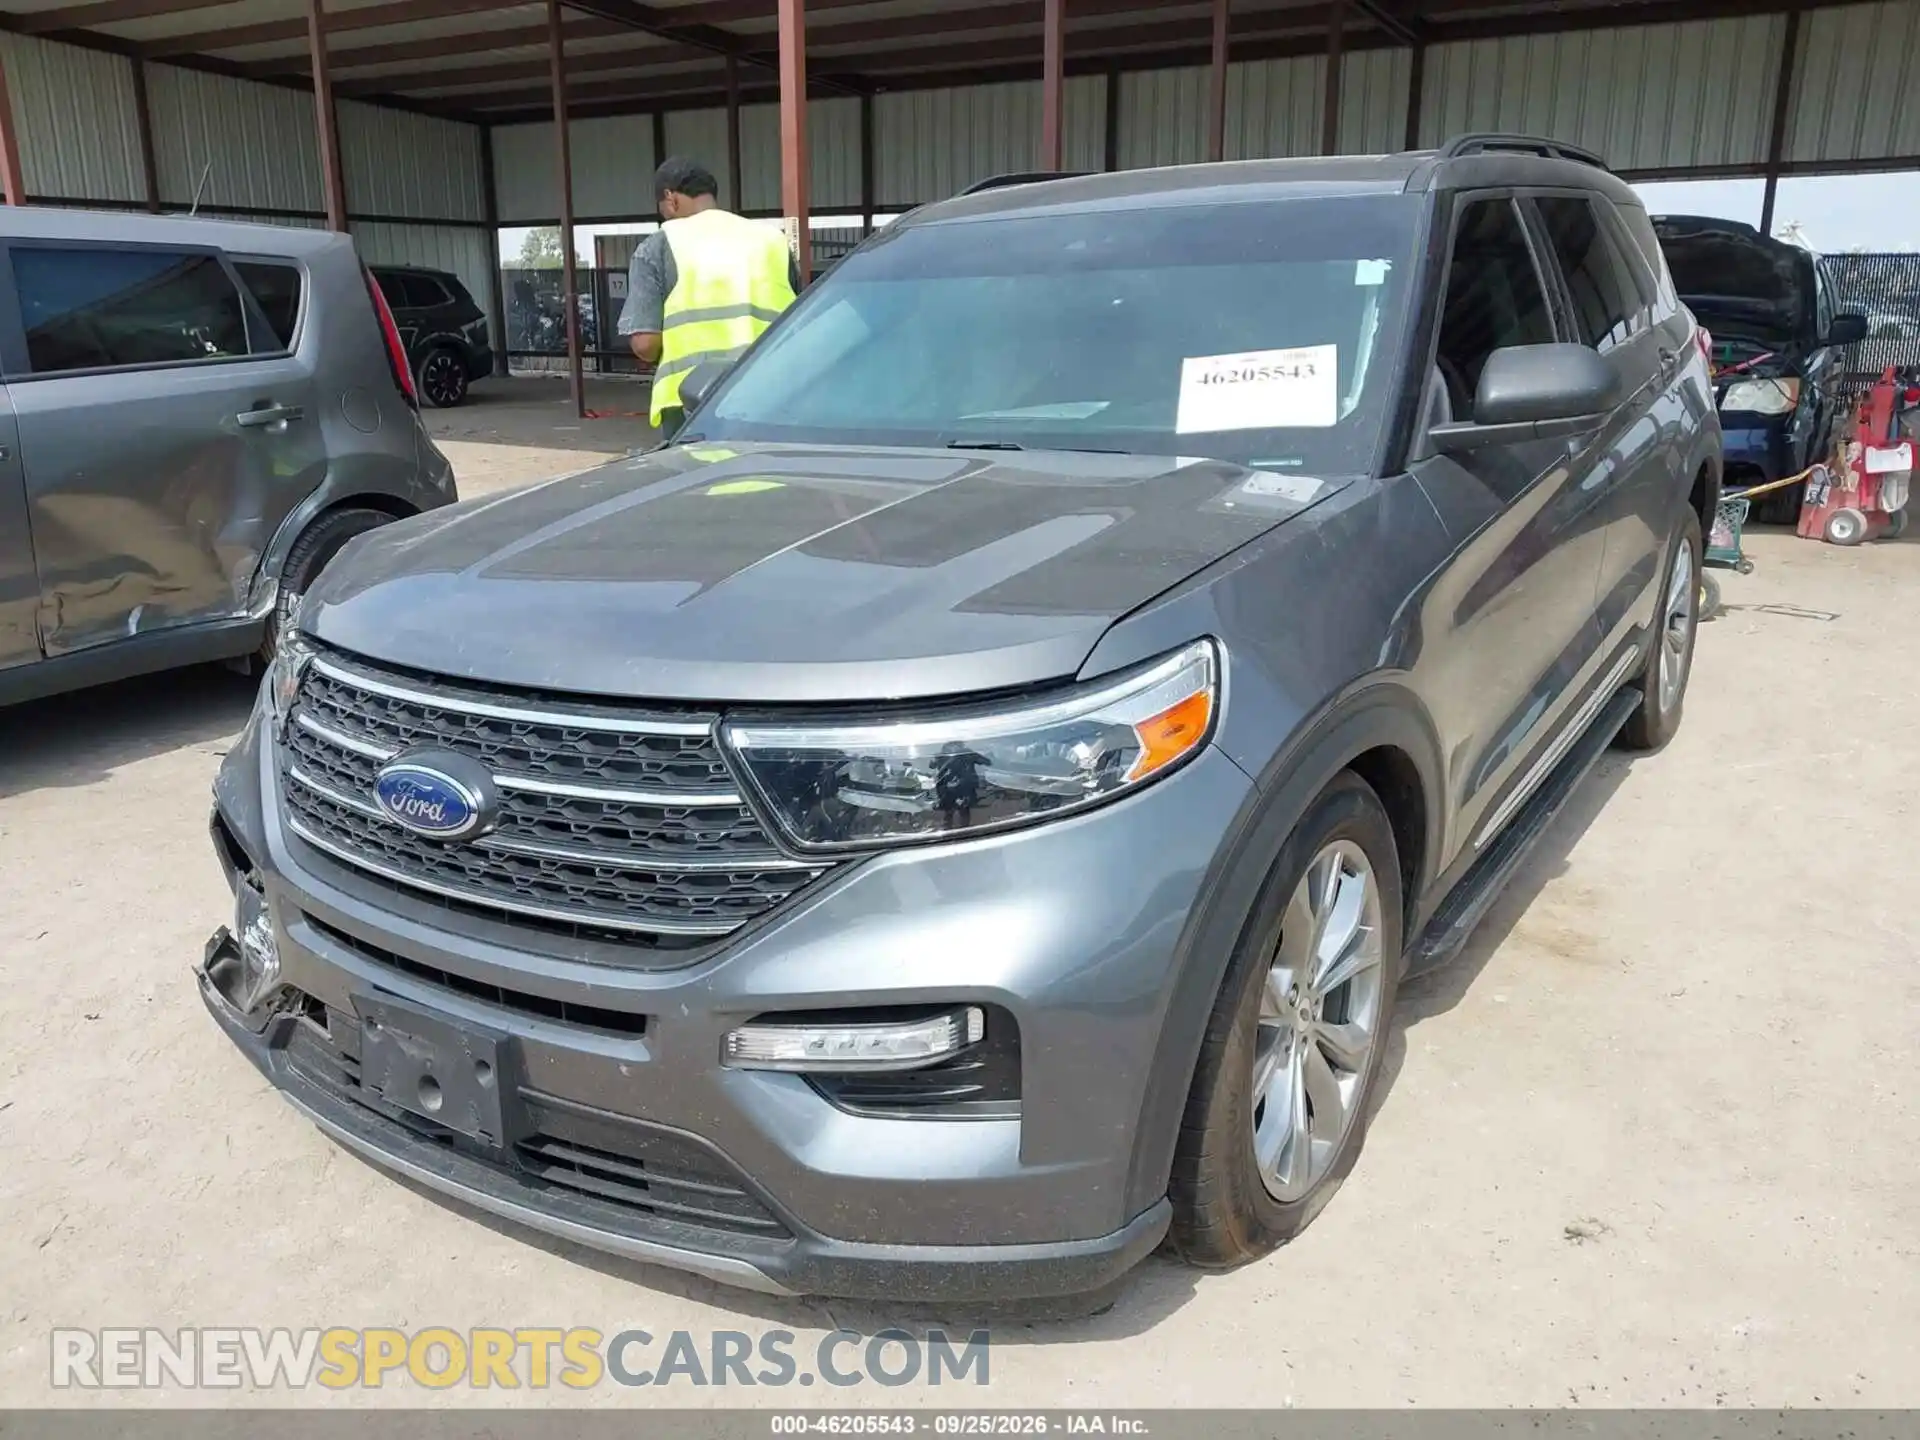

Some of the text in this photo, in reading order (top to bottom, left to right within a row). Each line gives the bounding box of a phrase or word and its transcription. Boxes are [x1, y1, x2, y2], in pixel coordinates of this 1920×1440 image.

[612, 280, 624, 290] 17
[1197, 363, 1317, 385] 46205543
[391, 778, 446, 822] Ford
